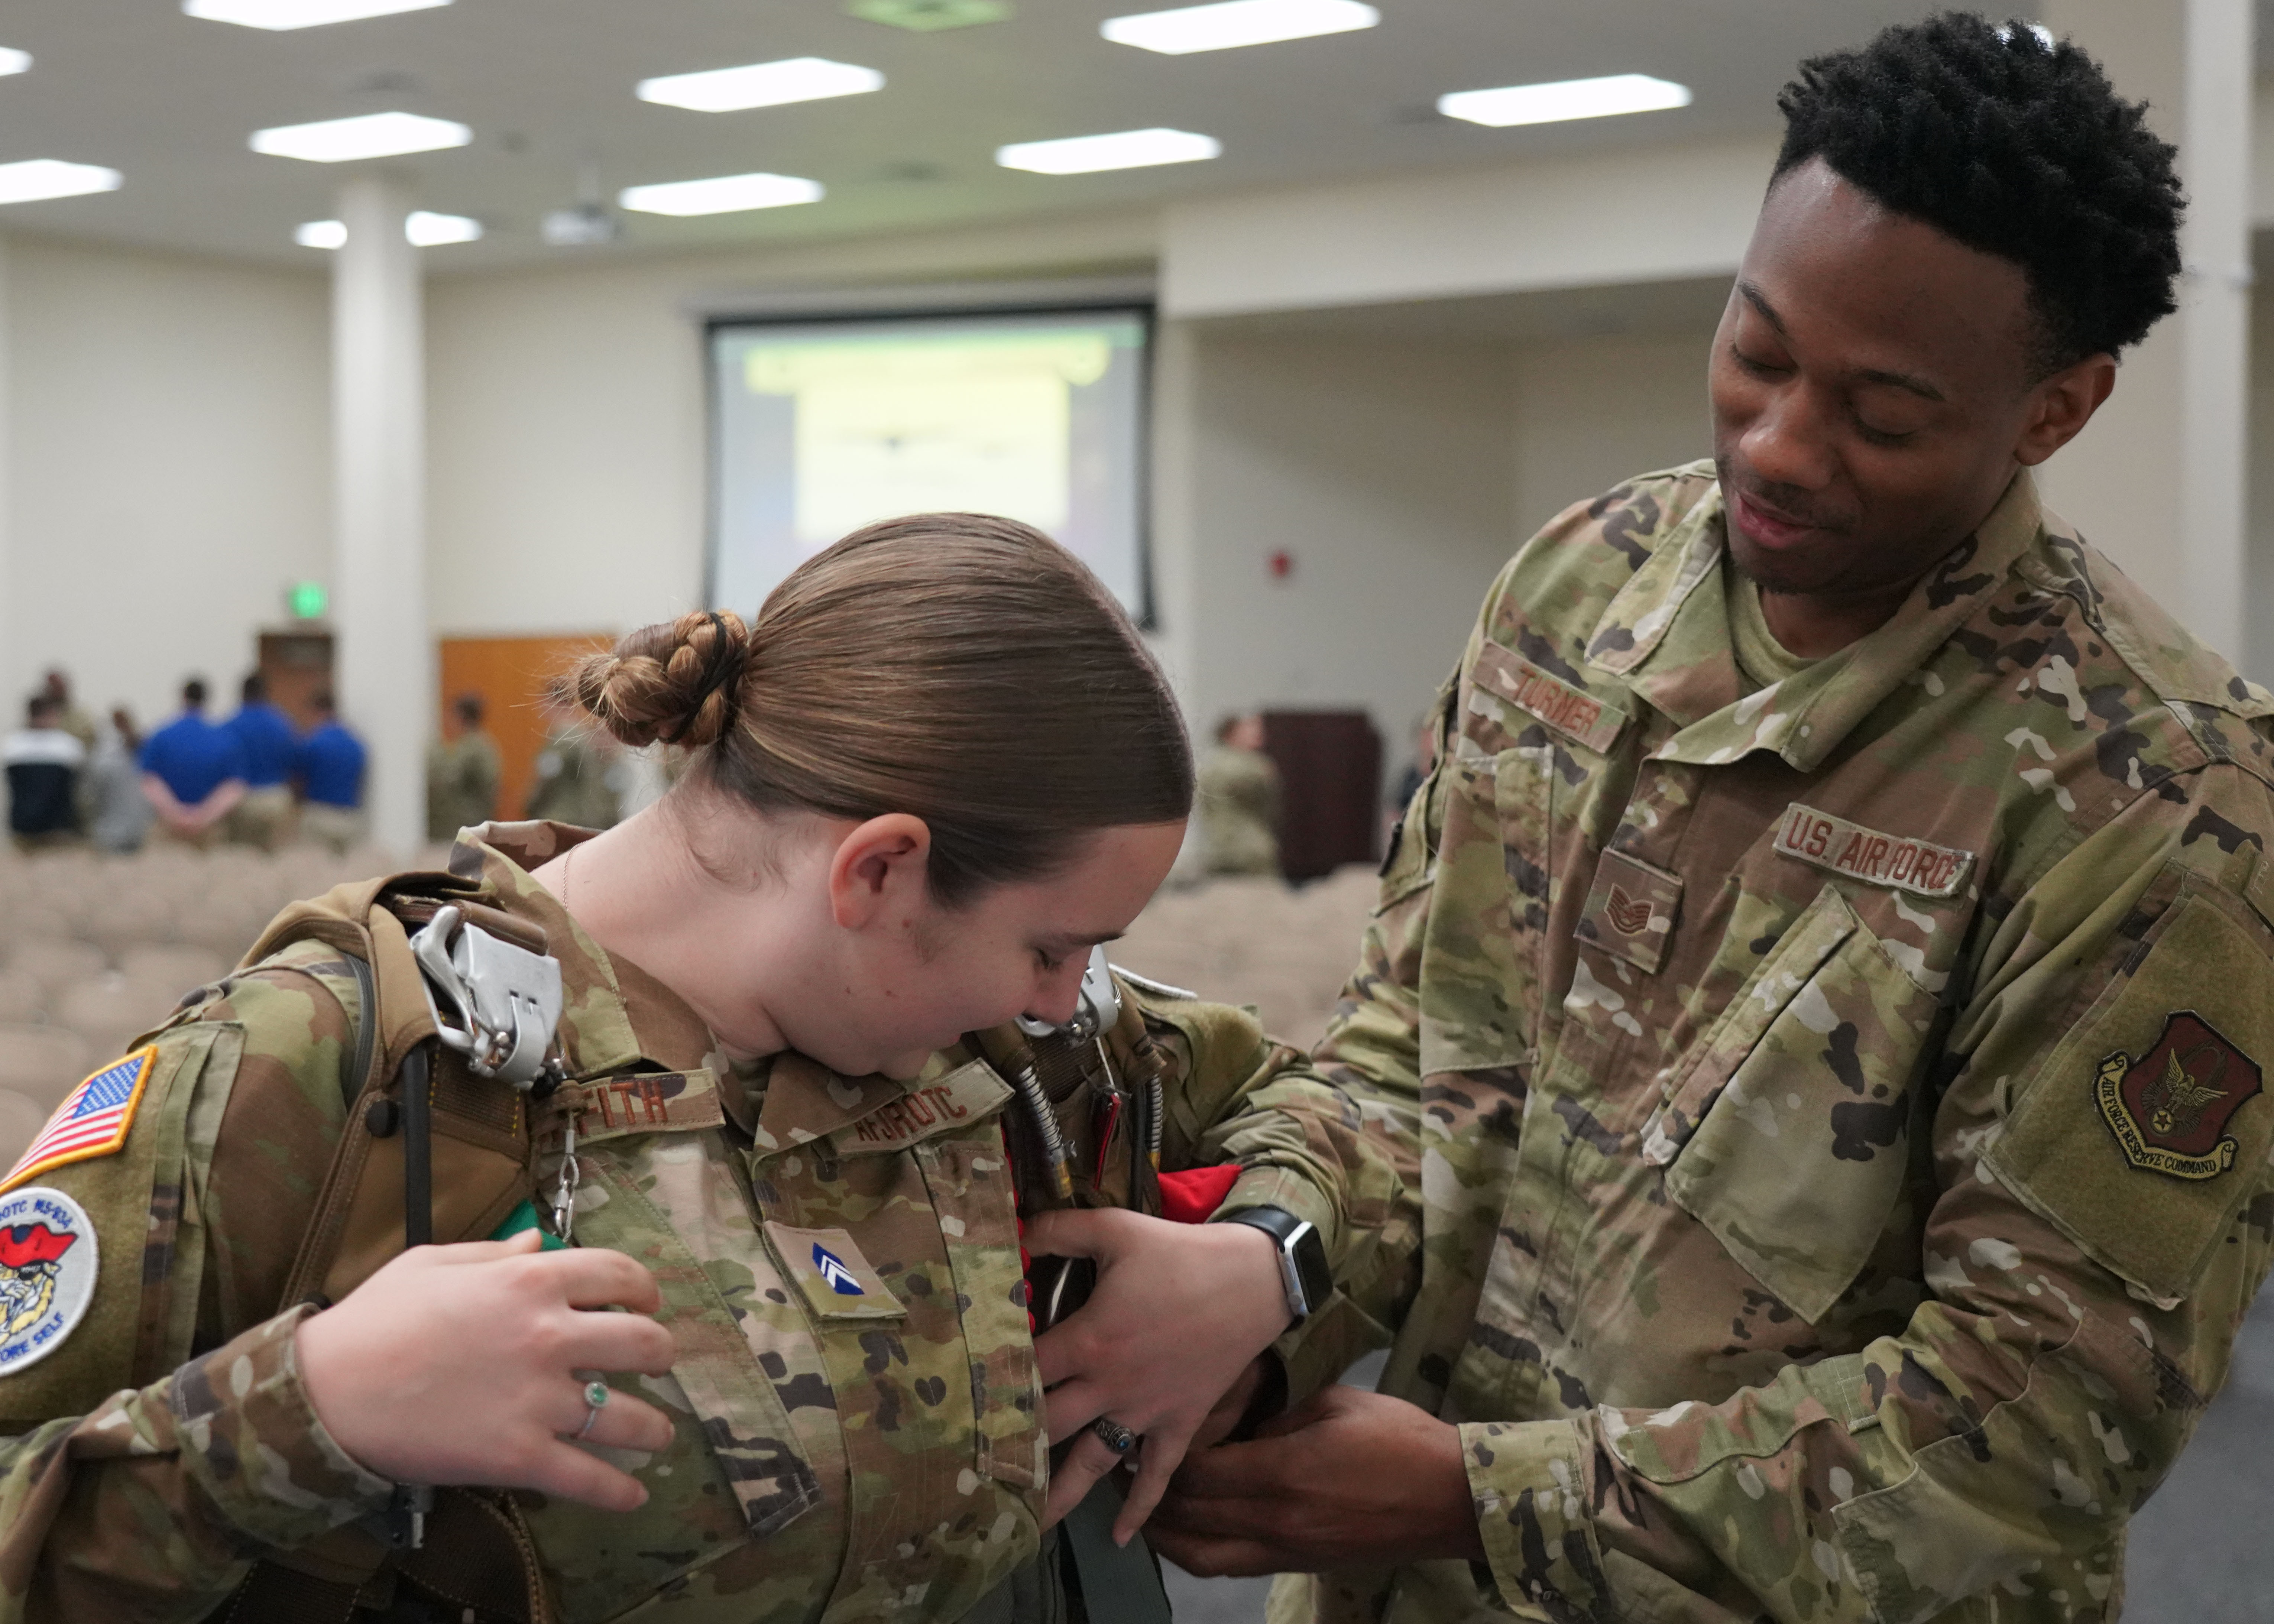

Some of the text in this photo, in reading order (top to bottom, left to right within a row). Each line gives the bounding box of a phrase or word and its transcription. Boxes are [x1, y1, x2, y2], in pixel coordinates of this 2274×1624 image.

[1513, 664, 1601, 736] TURNER
[1786, 811, 1962, 889] U.S. AIR FORCE
[2102, 1077, 2216, 1174] AIR FORCE RESERVE COMMAND
[33, 1311, 64, 1345] SELF
